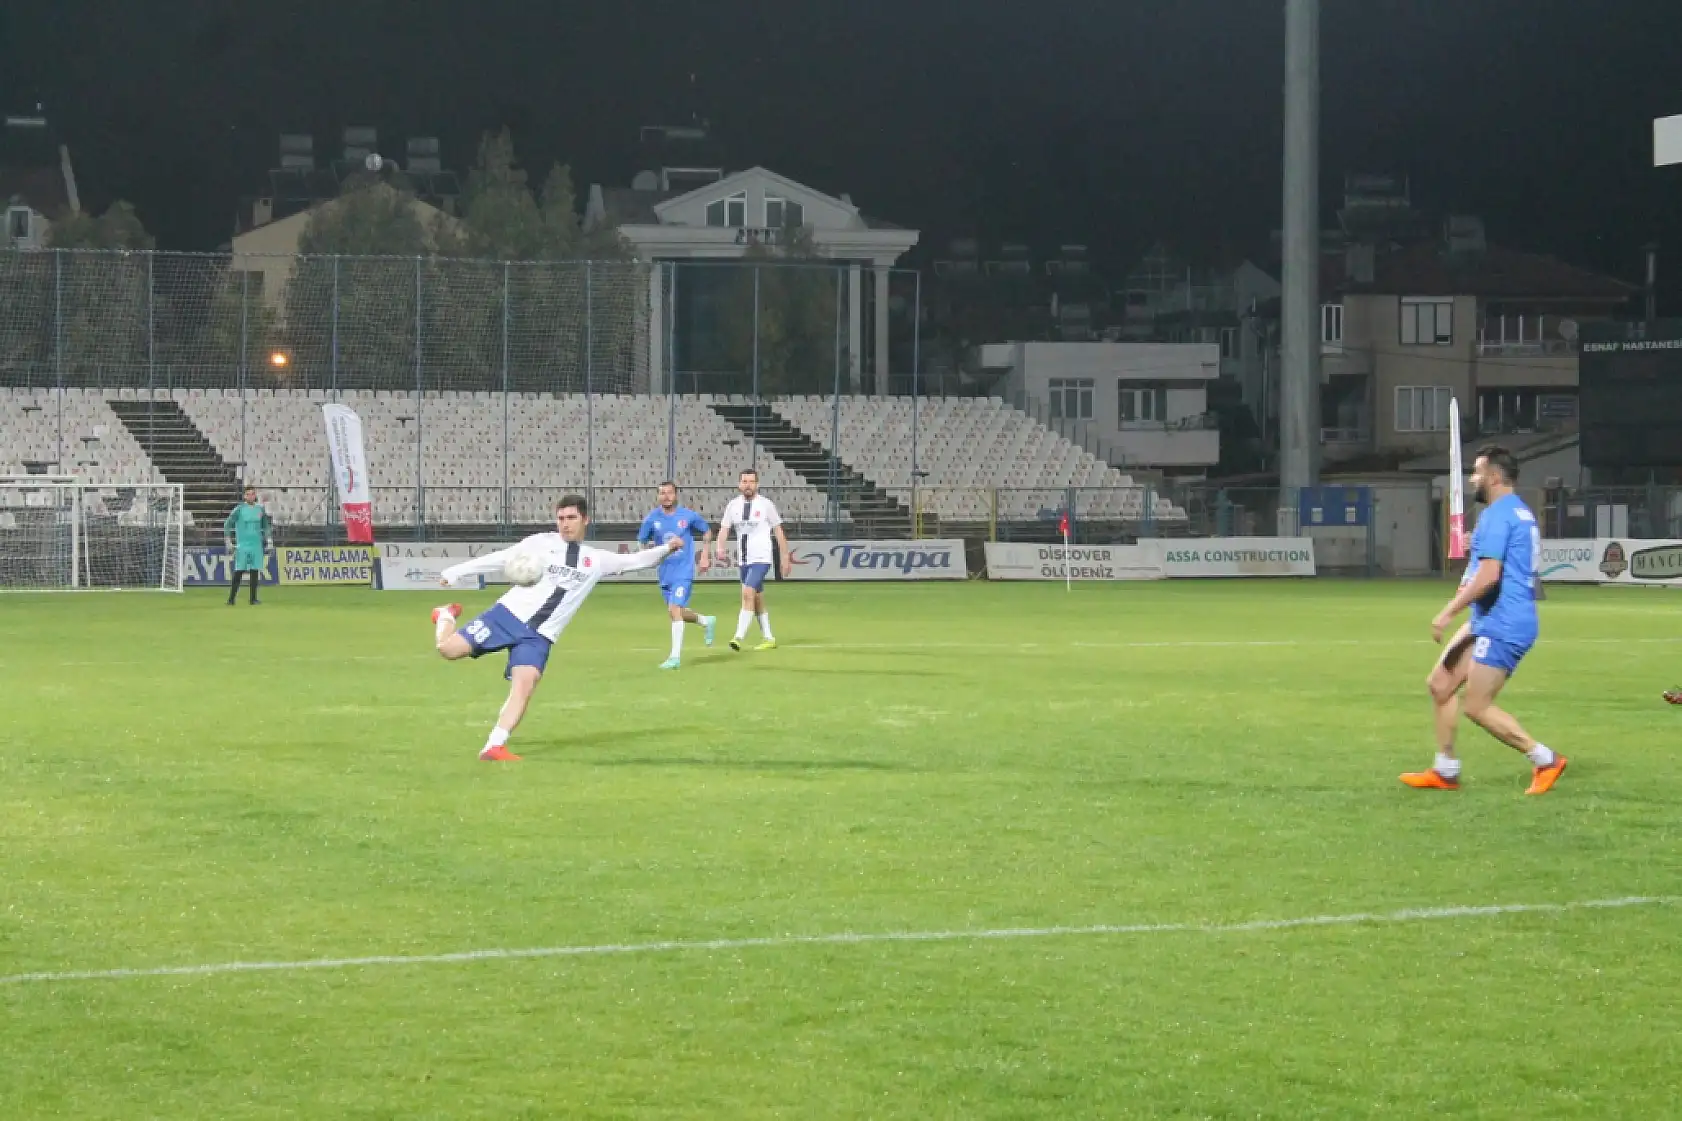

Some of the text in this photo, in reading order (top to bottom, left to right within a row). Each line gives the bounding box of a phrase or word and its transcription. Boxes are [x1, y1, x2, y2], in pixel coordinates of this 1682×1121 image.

[285, 549, 370, 563] PAZARLAMA
[829, 544, 951, 574] Tempa
[1166, 549, 1310, 563] ASSA CONSTRUCTION
[284, 565, 373, 580] YAPI MARKET
